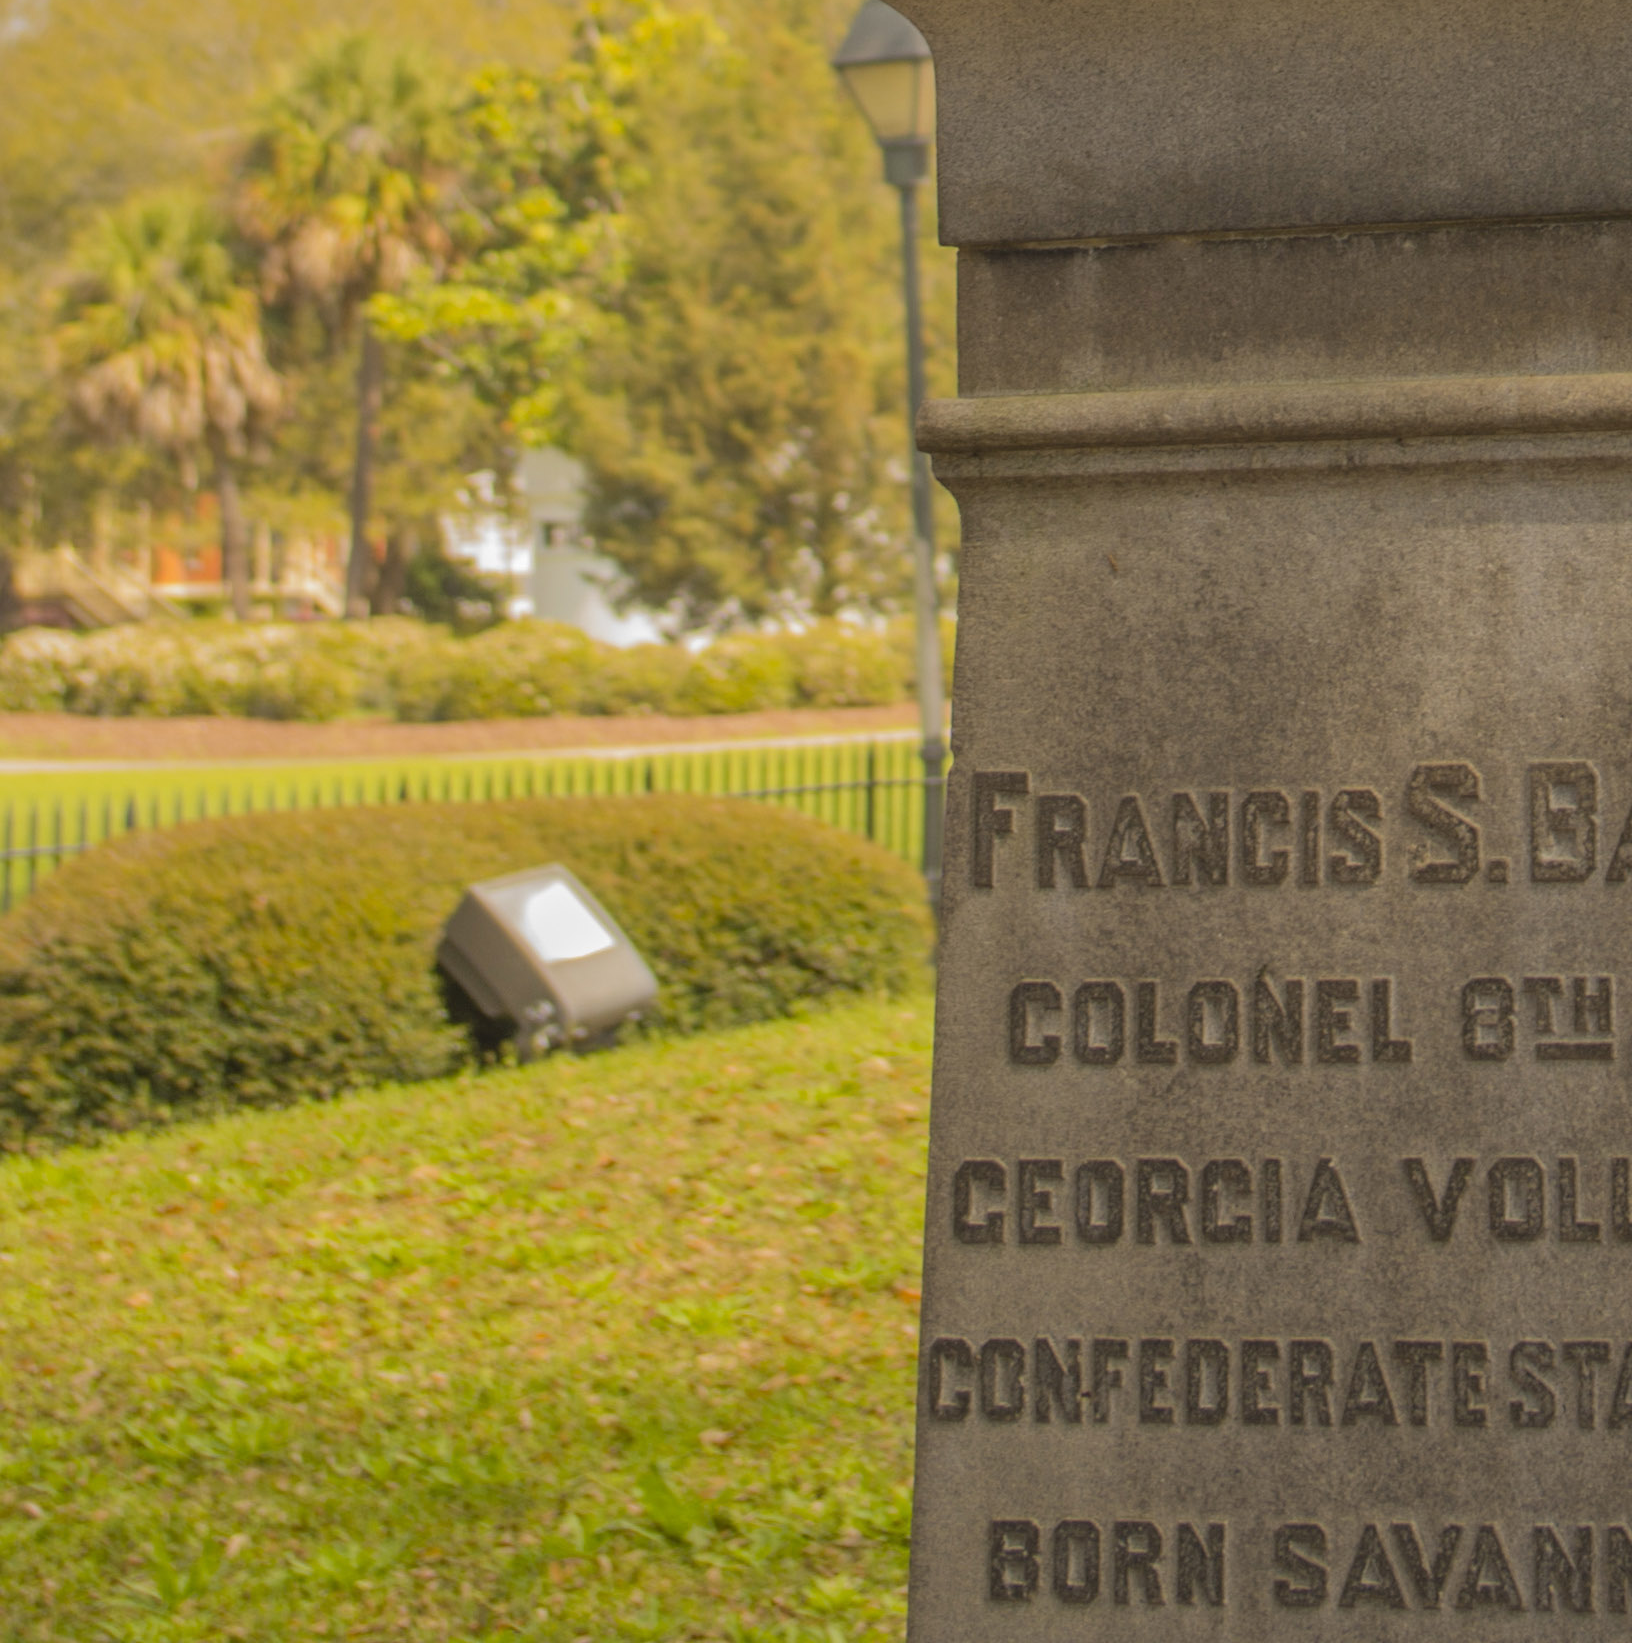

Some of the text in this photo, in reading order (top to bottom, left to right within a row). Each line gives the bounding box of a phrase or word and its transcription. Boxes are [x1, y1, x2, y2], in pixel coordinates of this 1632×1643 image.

[970, 771, 1386, 889] FRANCIS
[1405, 761, 1510, 887] S.
[1007, 975, 1413, 1065] COLONEL
[951, 1156, 1360, 1247] GEORGIA
[929, 1336, 1489, 1430] CONFEDERATE
[988, 1518, 1226, 1606] BORN
